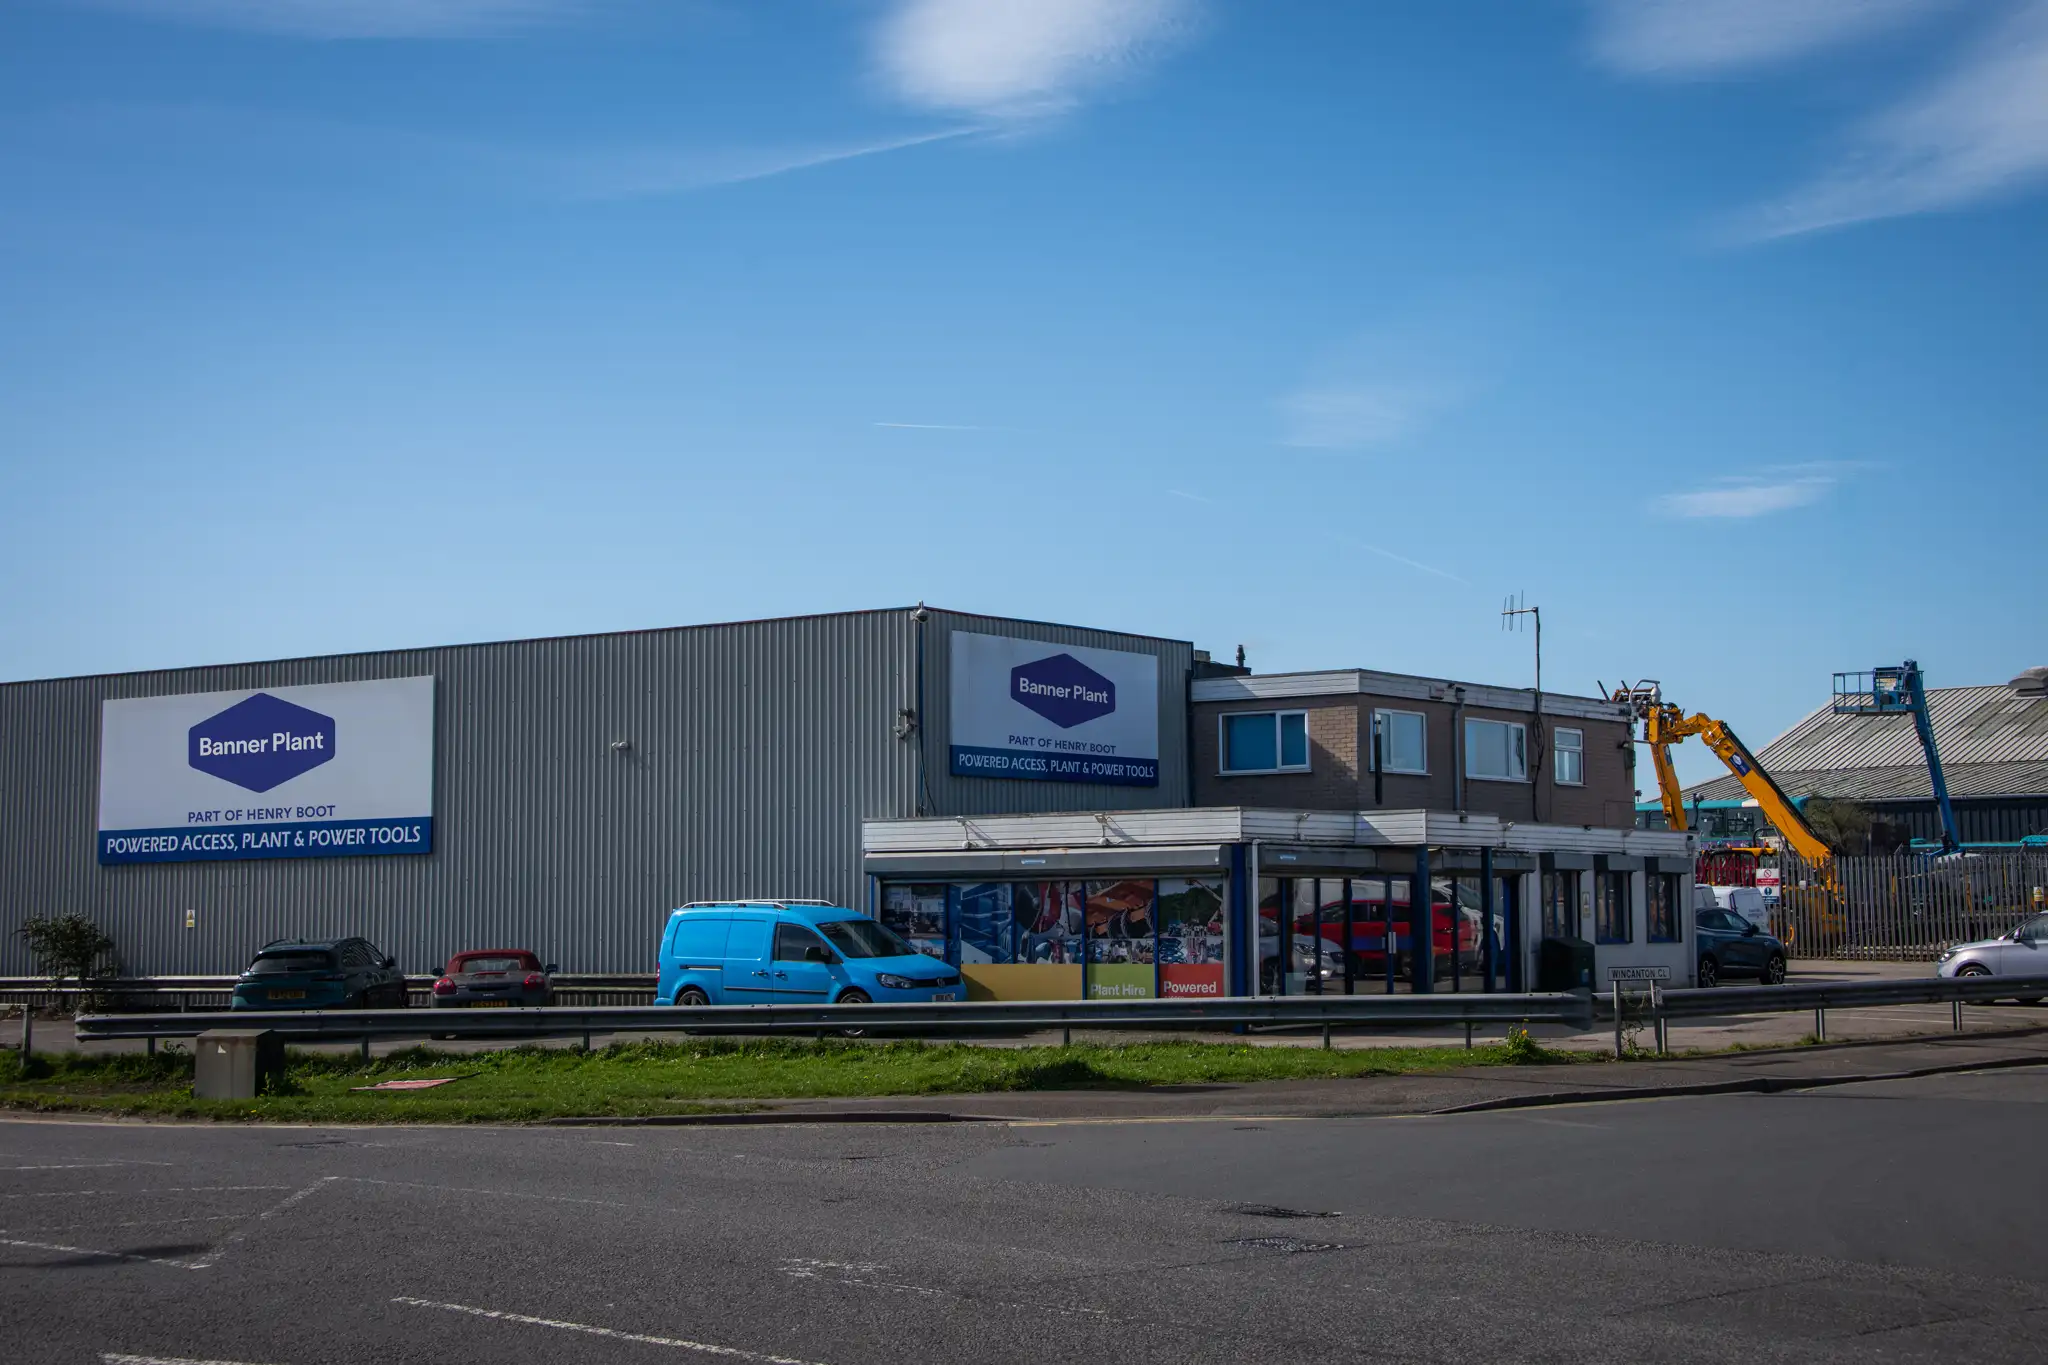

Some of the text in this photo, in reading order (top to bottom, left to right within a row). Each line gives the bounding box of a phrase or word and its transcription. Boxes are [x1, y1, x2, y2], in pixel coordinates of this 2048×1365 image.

[1019, 677, 1108, 704] Banner Plant
[199, 731, 324, 757] Banner Plant
[1008, 735, 1116, 754] PART OF HENRY BOOT
[959, 753, 1154, 778] POWERED ACCESS, PLANT & POWER TOOLS
[188, 805, 336, 823] PART OF HENRY BOOT
[106, 826, 421, 854] POWERED ACCESS, PLANT & POWER TOOLS
[1612, 969, 1656, 978] WINCANTON
[1090, 983, 1146, 996] Plant Hire
[1163, 981, 1217, 994] Powered
